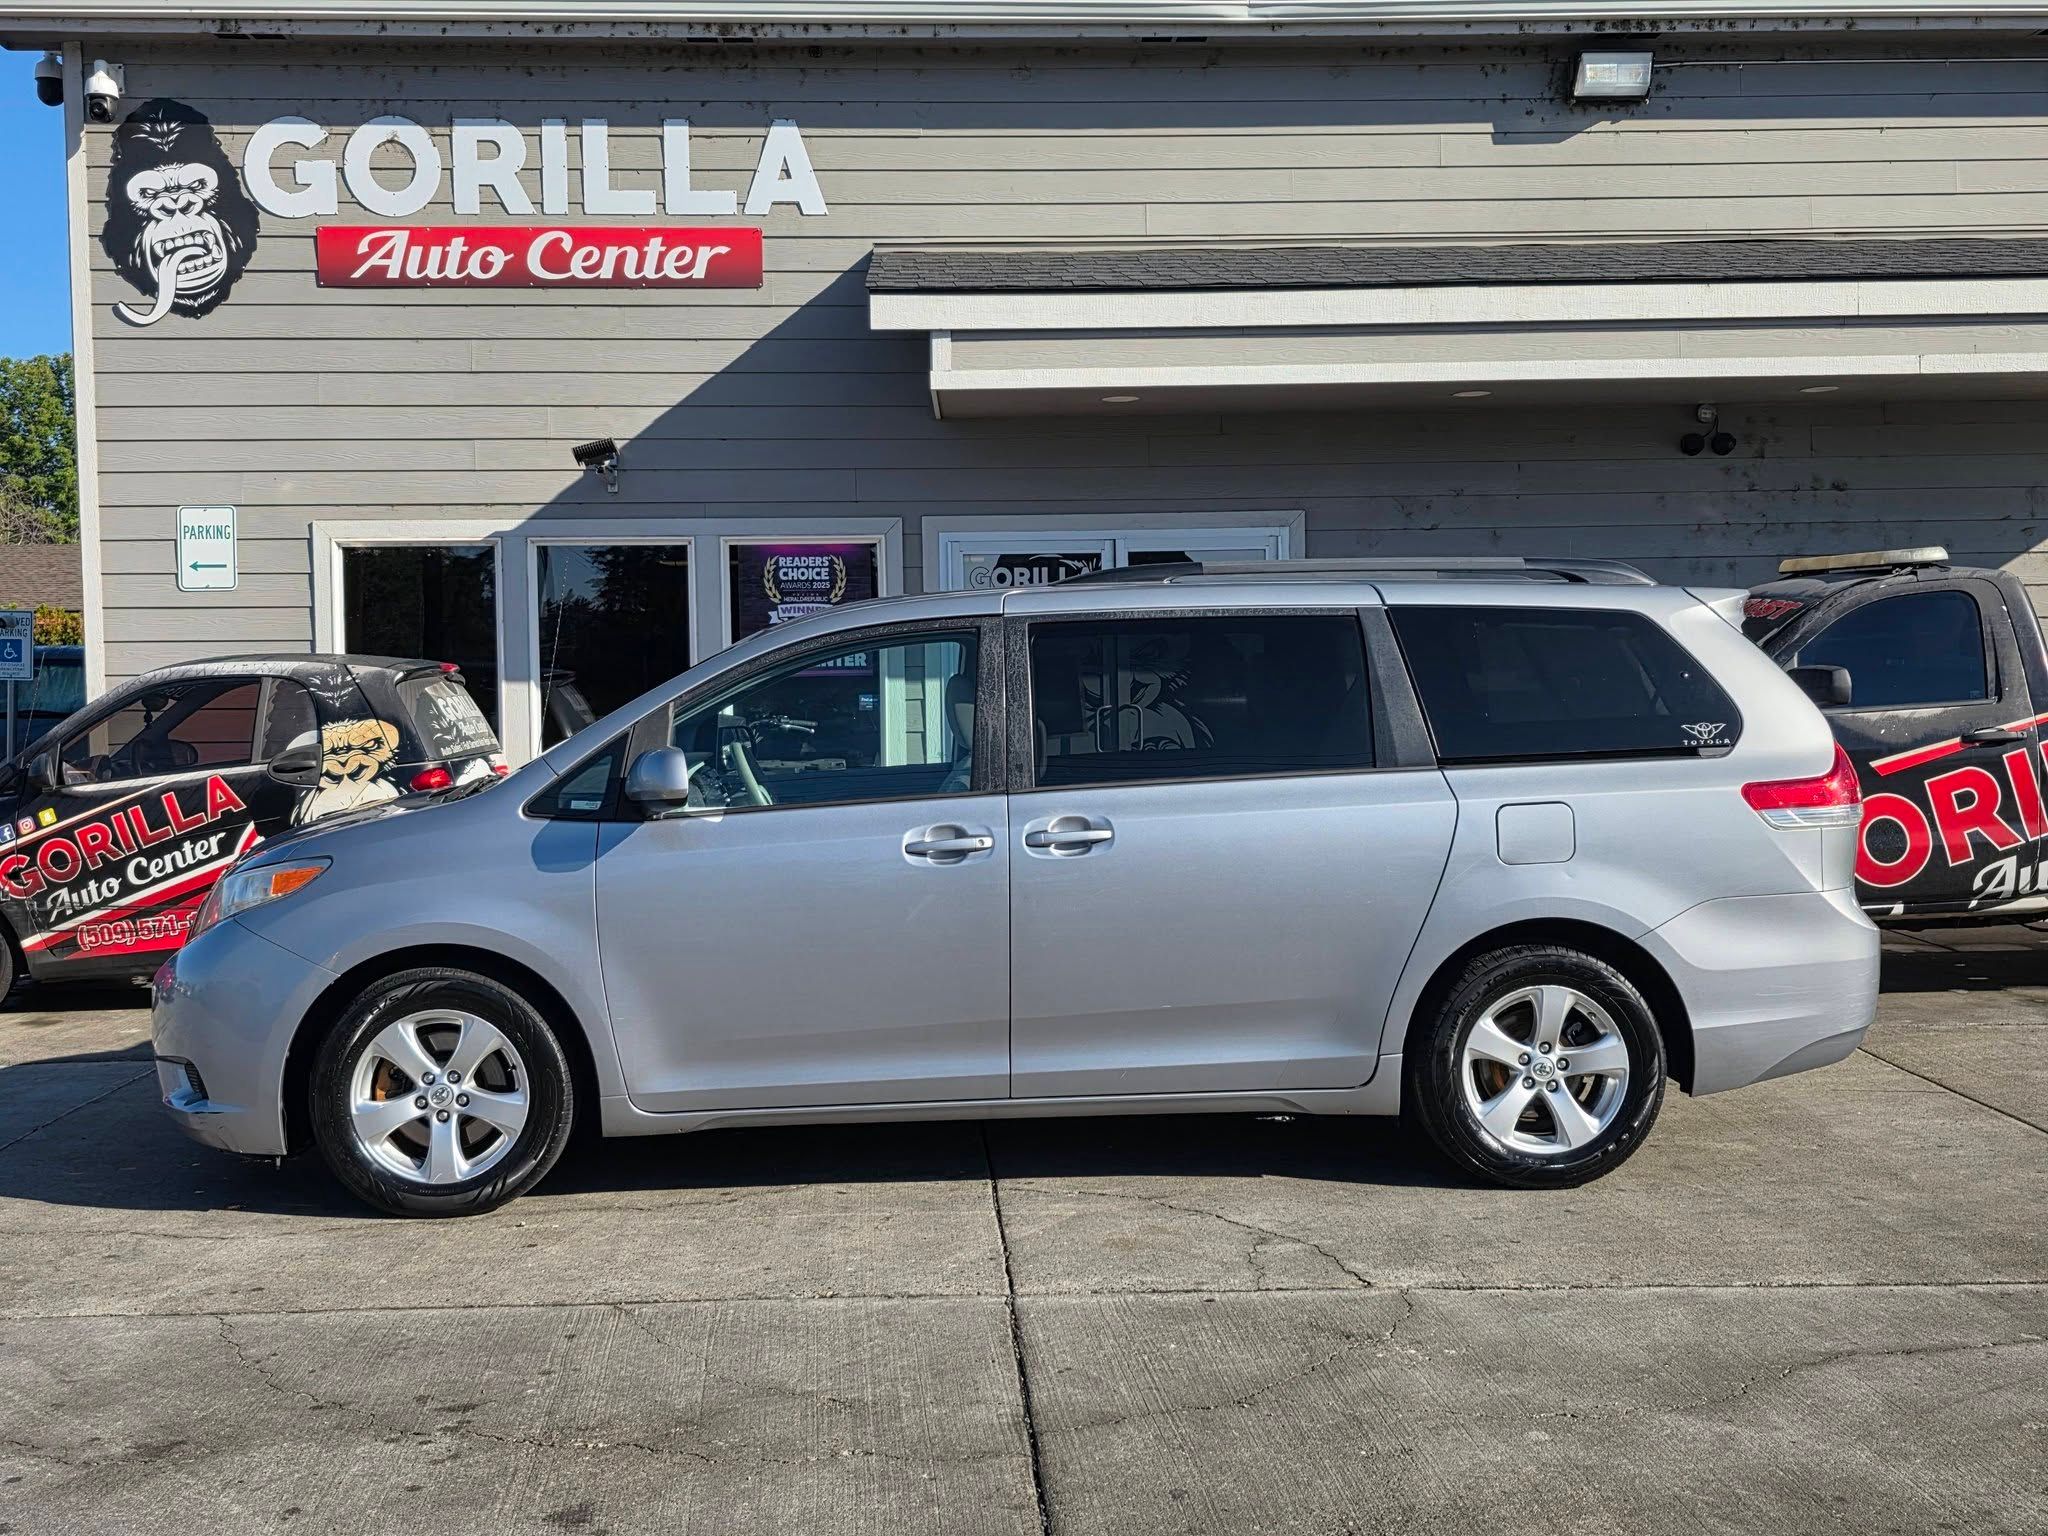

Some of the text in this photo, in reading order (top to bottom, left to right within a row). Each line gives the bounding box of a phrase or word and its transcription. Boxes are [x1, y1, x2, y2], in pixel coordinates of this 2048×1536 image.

[244, 115, 829, 218] GORILLA
[350, 230, 731, 280] Auto Center
[183, 524, 231, 540] PARKING
[778, 556, 831, 567] READERS'
[778, 567, 830, 580] CHOICE
[812, 581, 831, 589] 2025
[0, 629, 28, 637] ARKING
[0, 774, 247, 899] GORILLA
[48, 832, 226, 922] Auto Center
[77, 919, 136, 951] (509)
